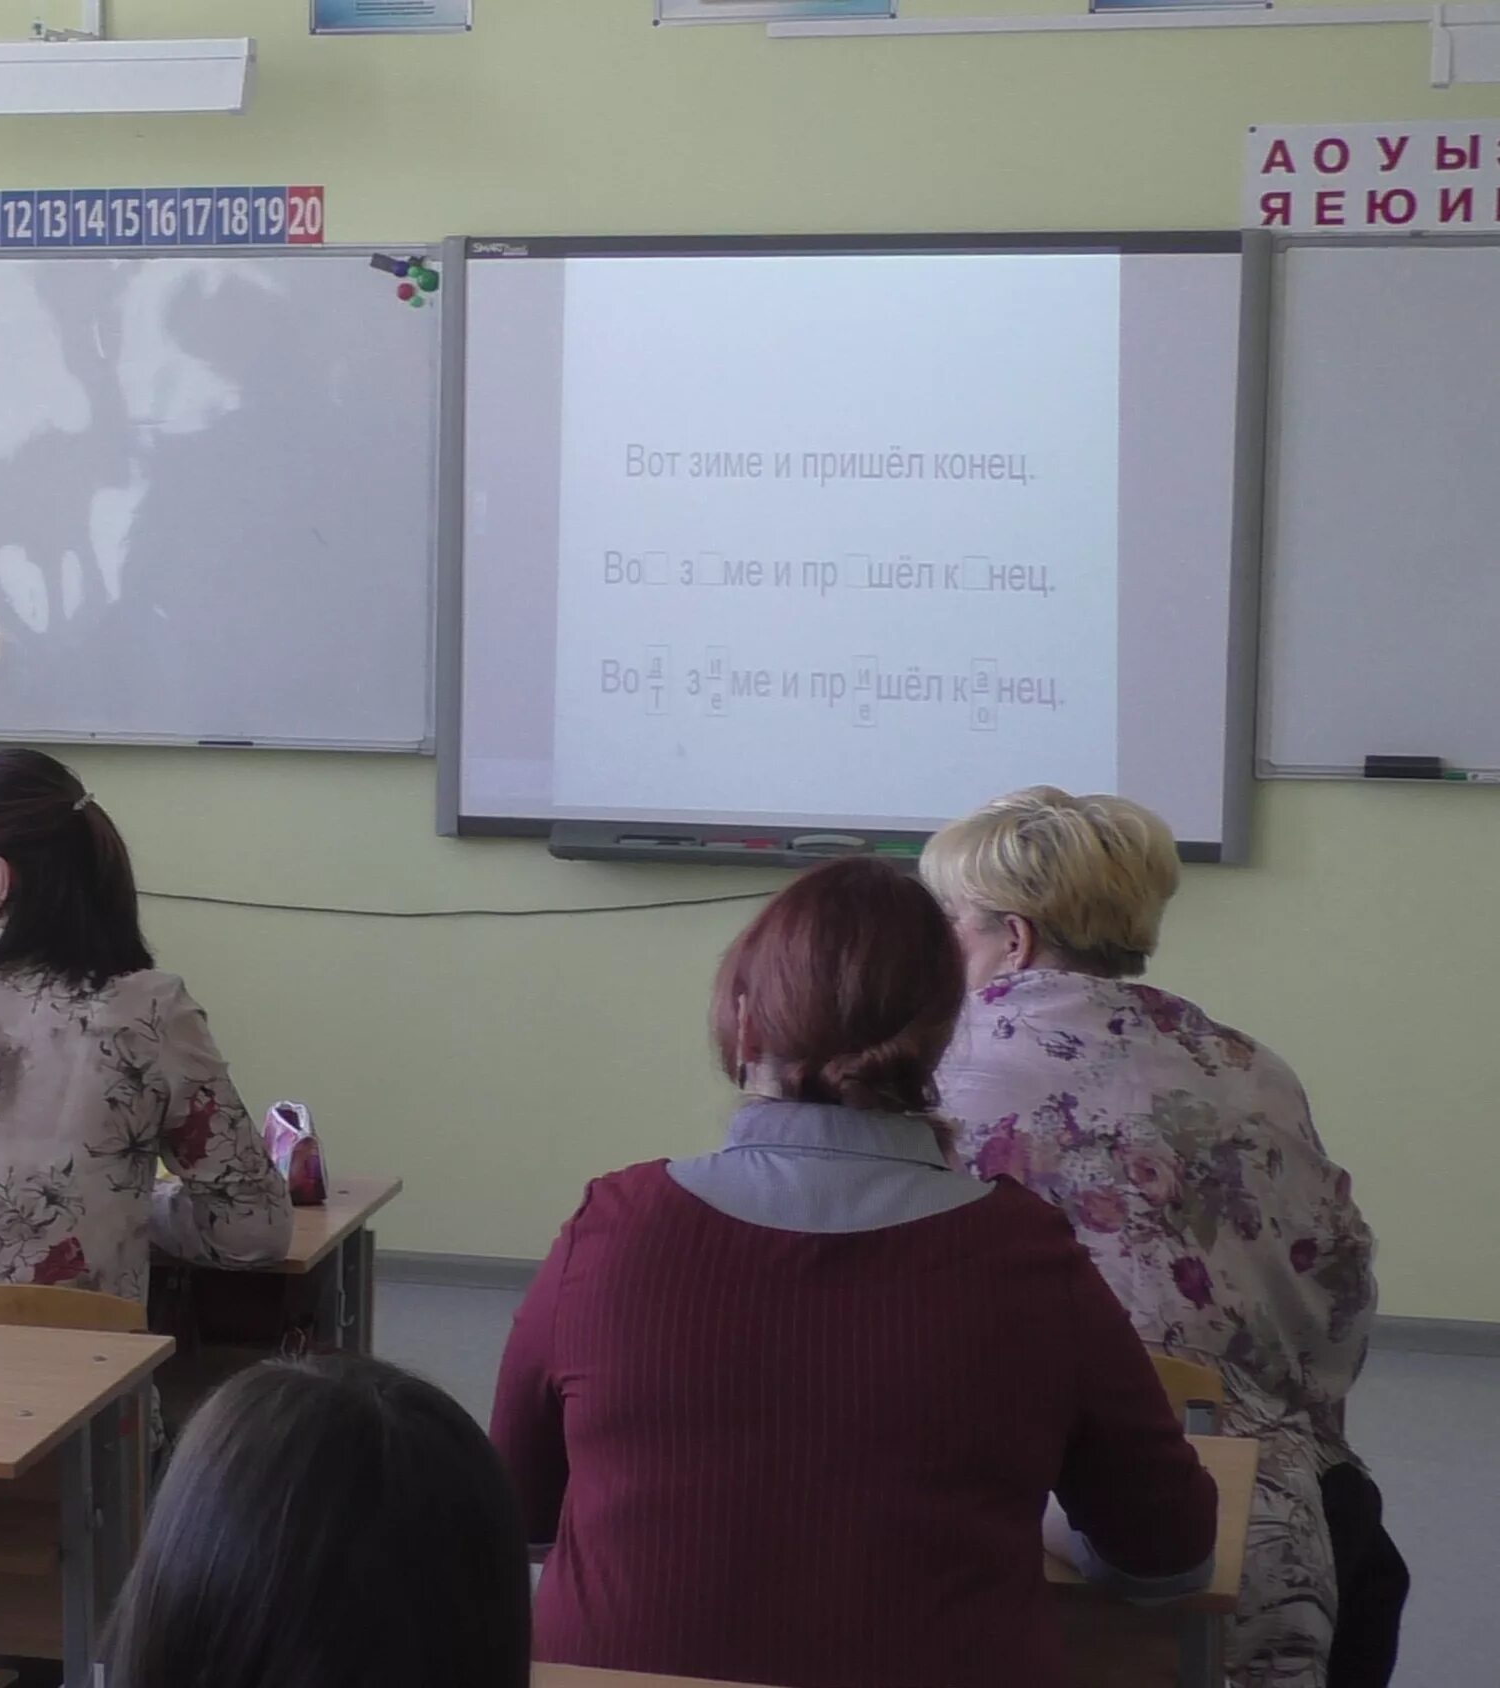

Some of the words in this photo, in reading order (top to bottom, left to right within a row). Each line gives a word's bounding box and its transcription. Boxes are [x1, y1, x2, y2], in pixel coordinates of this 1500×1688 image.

[1260, 139, 1297, 175] А
[1313, 137, 1350, 175] О
[1375, 135, 1410, 172] У
[1436, 134, 1481, 171] Ы
[3, 200, 32, 239] 12
[39, 200, 67, 238] 13
[74, 199, 106, 237] 14
[111, 199, 140, 237] 15
[146, 198, 177, 236] 16
[182, 198, 211, 236] 17
[218, 197, 248, 235] 18
[254, 196, 285, 235] 19
[288, 196, 322, 235] 20
[1260, 191, 1292, 226] Я
[1315, 190, 1346, 226] Е
[1366, 188, 1418, 225] Ю
[1439, 187, 1473, 223] И
[625, 443, 680, 478] Вот
[689, 451, 763, 478] зиме
[774, 452, 791, 478] и
[801, 445, 924, 488] пришёл
[934, 452, 1036, 488] конец.
[774, 560, 791, 587] и
[782, 671, 799, 698] и
